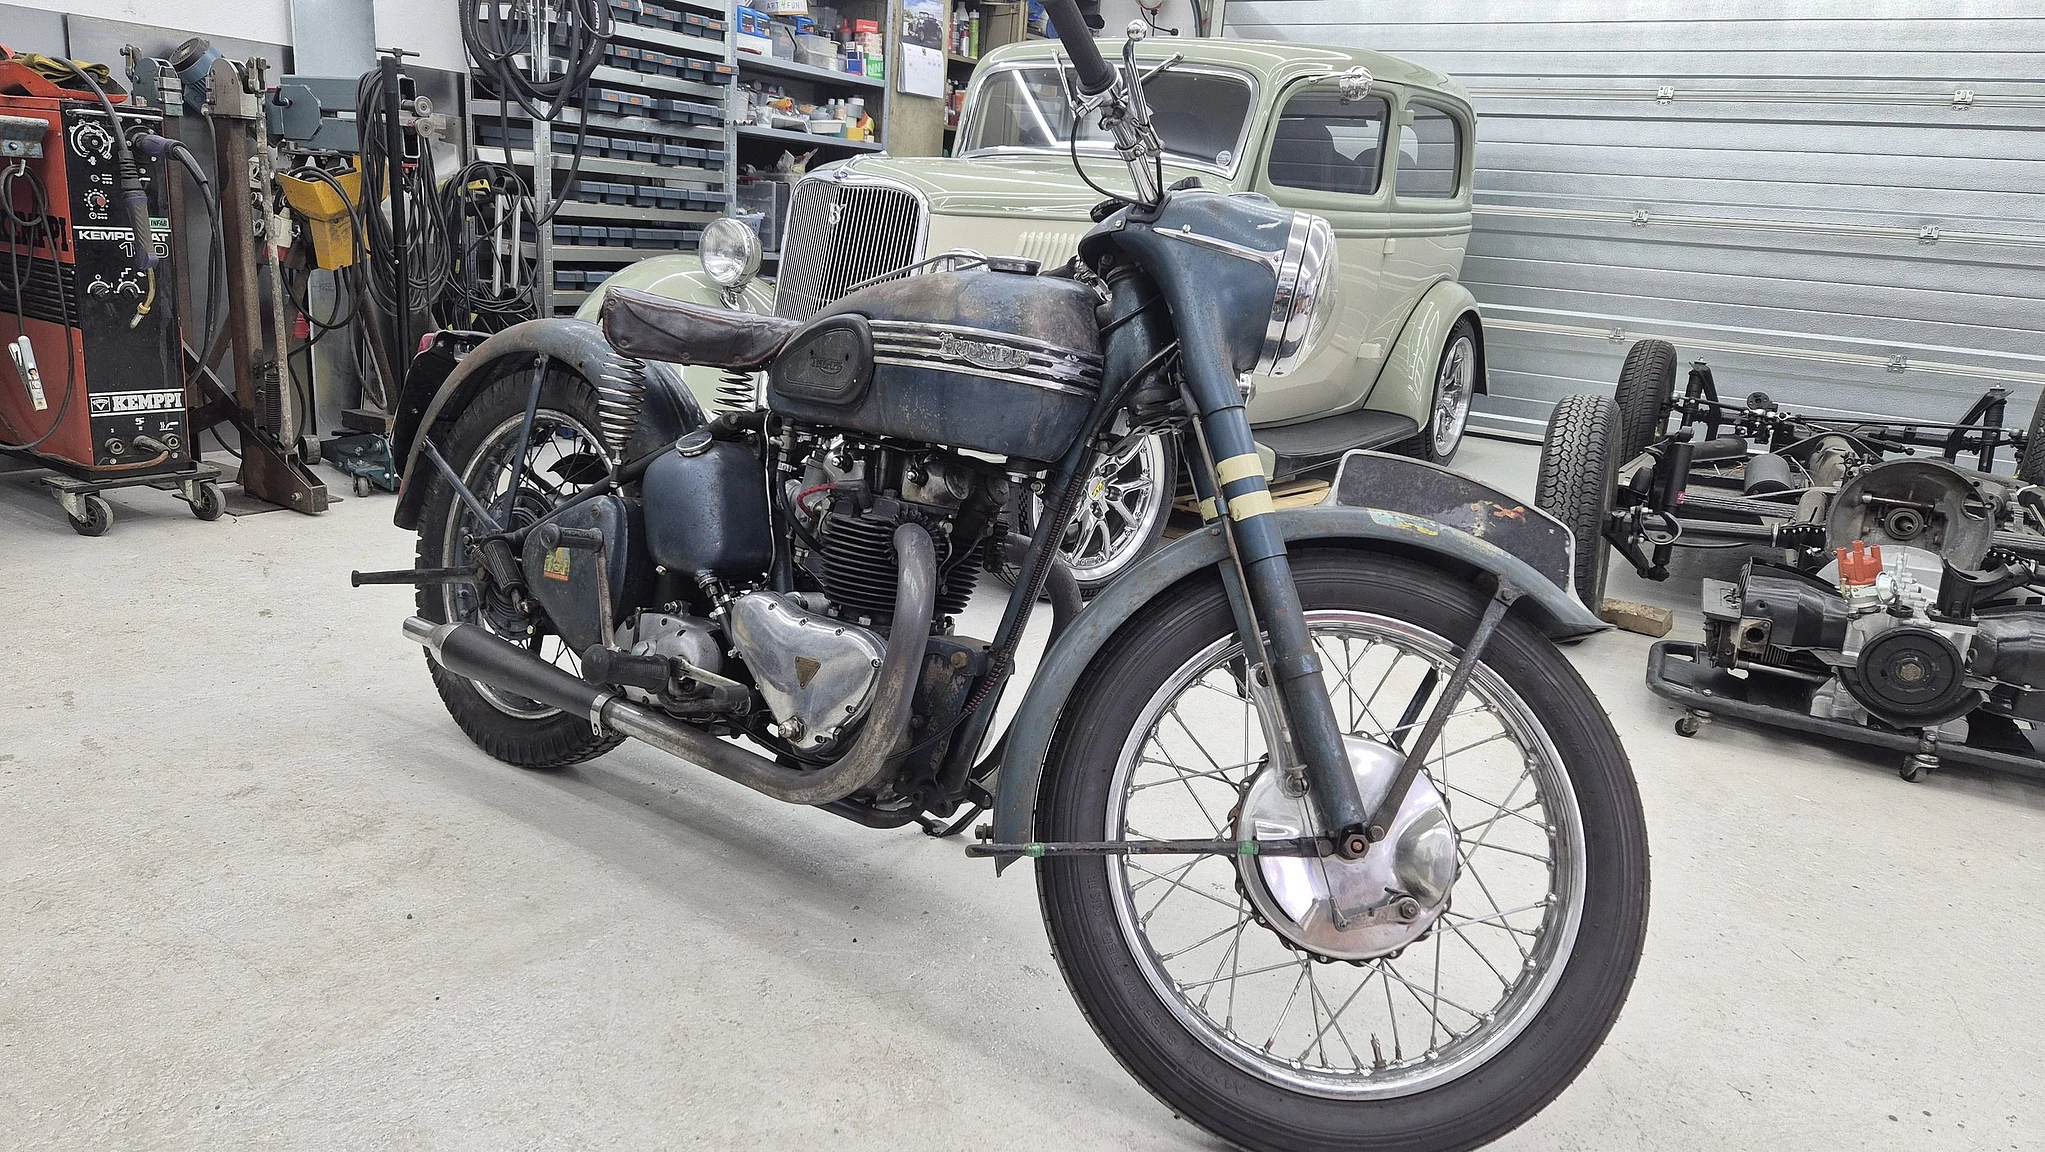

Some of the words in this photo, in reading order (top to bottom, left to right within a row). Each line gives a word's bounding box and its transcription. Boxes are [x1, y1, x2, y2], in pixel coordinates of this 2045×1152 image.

[78, 230, 169, 242] KEMPOAT
[119, 241, 169, 259] 10
[938, 331, 1031, 369] TRIUMPH
[111, 392, 183, 412] KEMPPI
